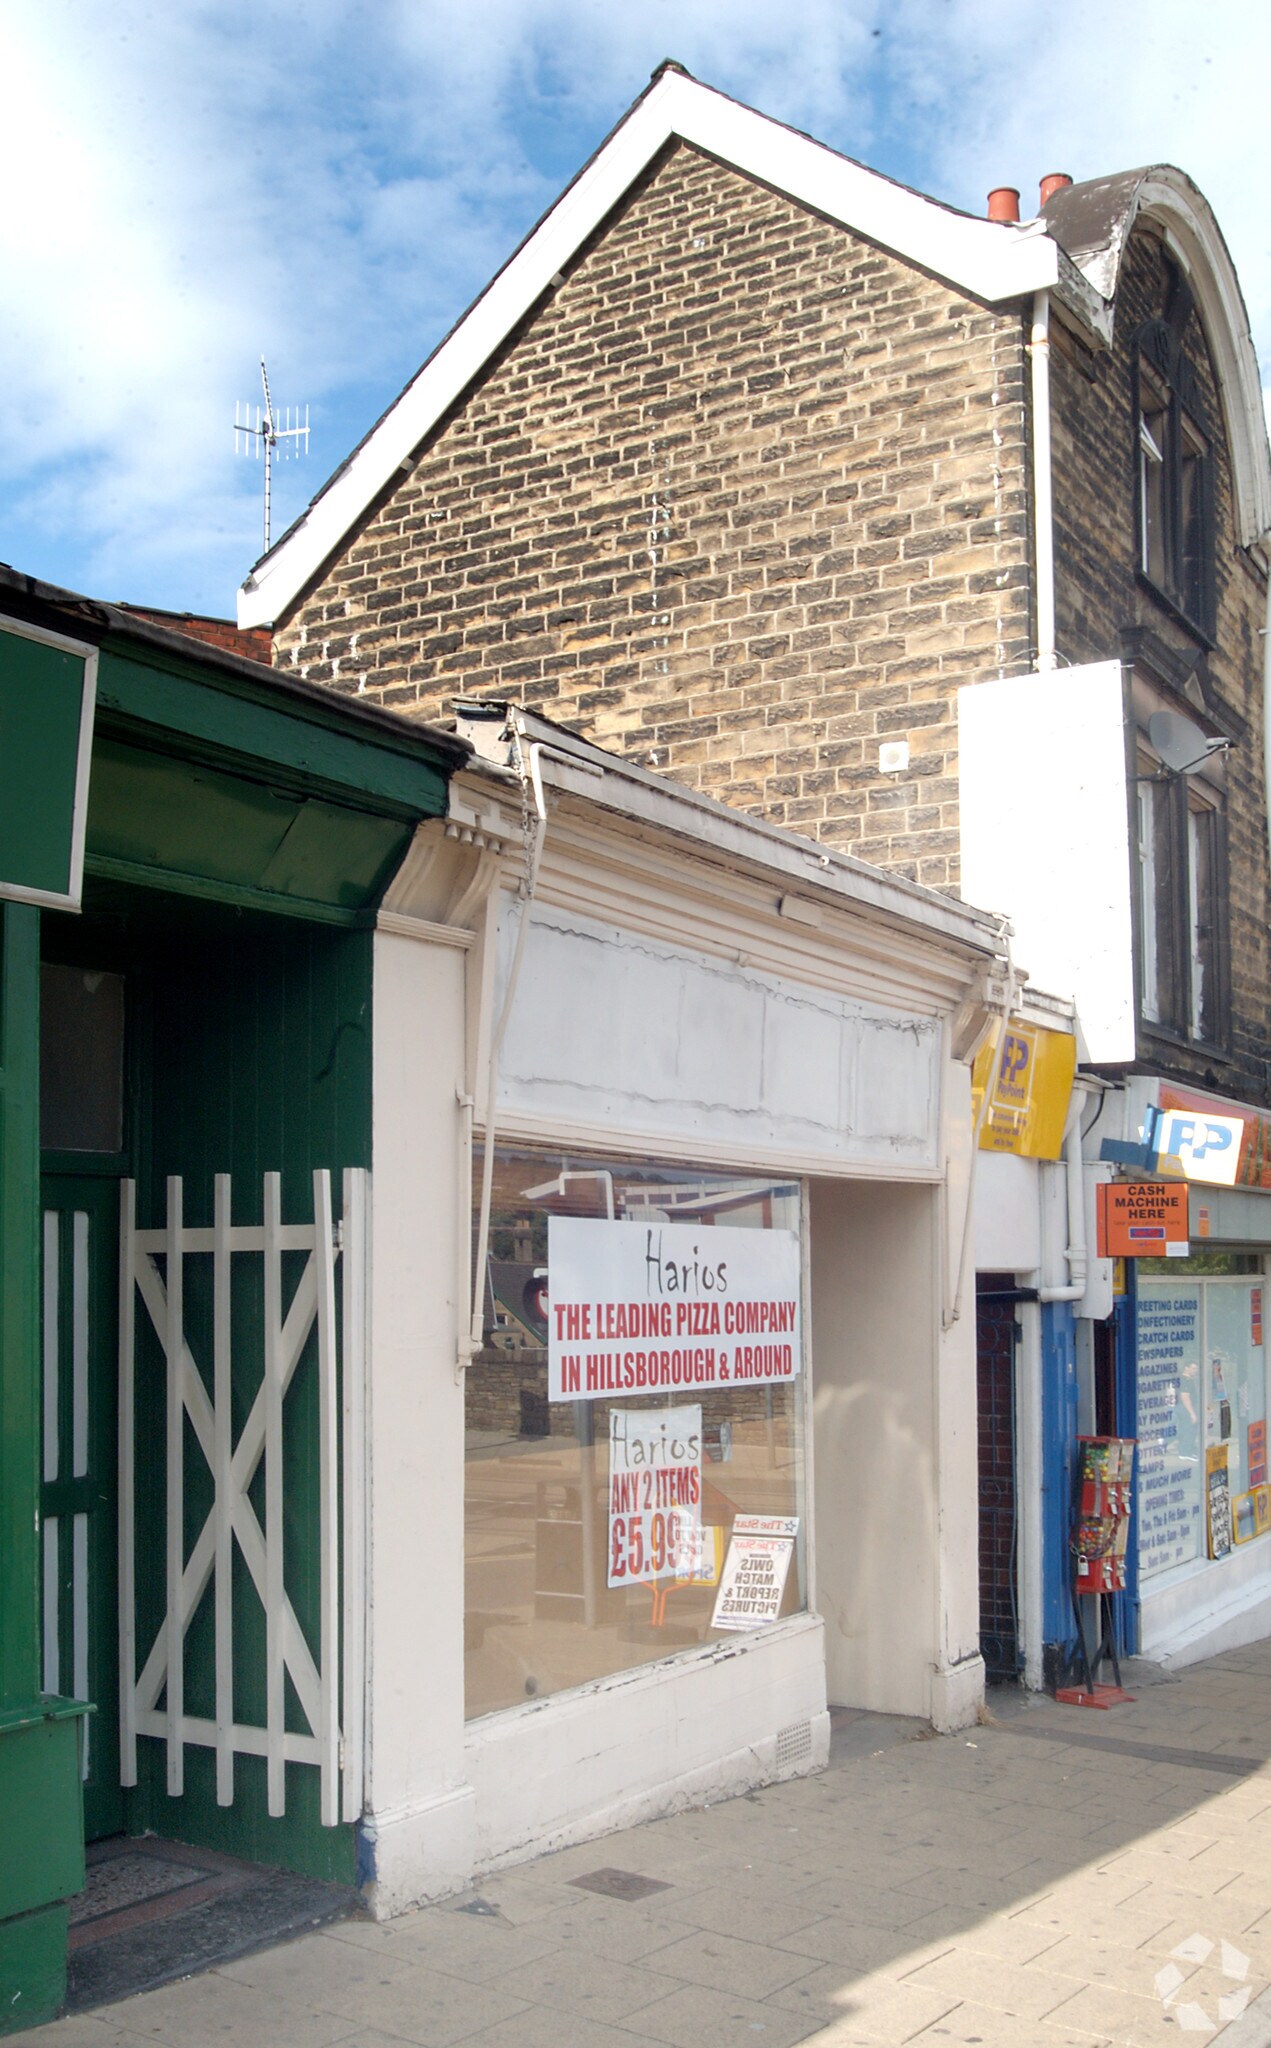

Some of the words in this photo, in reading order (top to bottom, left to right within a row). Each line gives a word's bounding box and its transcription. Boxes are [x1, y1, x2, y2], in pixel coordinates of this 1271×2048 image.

[1128, 1186, 1165, 1196] CASH
[1115, 1197, 1179, 1207] MACHINE
[1129, 1209, 1165, 1218] HERE
[646, 1229, 727, 1296] Harios
[1137, 1300, 1172, 1312] REETING
[1174, 1300, 1197, 1311] CARDS
[554, 1304, 591, 1341] THE
[597, 1302, 672, 1339] LEADING
[677, 1302, 721, 1336] PIZZA
[725, 1301, 796, 1334] COMPANY
[1137, 1315, 1195, 1328] ONFECTIONERY
[1137, 1332, 1168, 1344] CRATCH
[1170, 1331, 1195, 1342] CARDS
[1138, 1346, 1184, 1361] EWSPAPERS
[561, 1356, 580, 1392] IN
[586, 1348, 715, 1390] HILLSBOROUGH
[719, 1352, 729, 1380] &
[734, 1344, 792, 1379] AROUND
[1137, 1363, 1178, 1376] AGAZINES
[1136, 1378, 1180, 1393] IGARETTES
[1138, 1395, 1178, 1410] EVERAGES
[1138, 1415, 1147, 1426] AY
[1150, 1410, 1173, 1424] POINT
[1138, 1426, 1177, 1442] ROCERIES
[612, 1414, 699, 1470] Harios
[1138, 1443, 1168, 1458] OTTERY
[1146, 1474, 1169, 1490] MUCH
[1171, 1468, 1192, 1483] MORE
[611, 1472, 639, 1514] ANY
[643, 1470, 652, 1510] 2
[656, 1466, 699, 1508] ITEMS
[611, 1512, 682, 1578] £5.99
